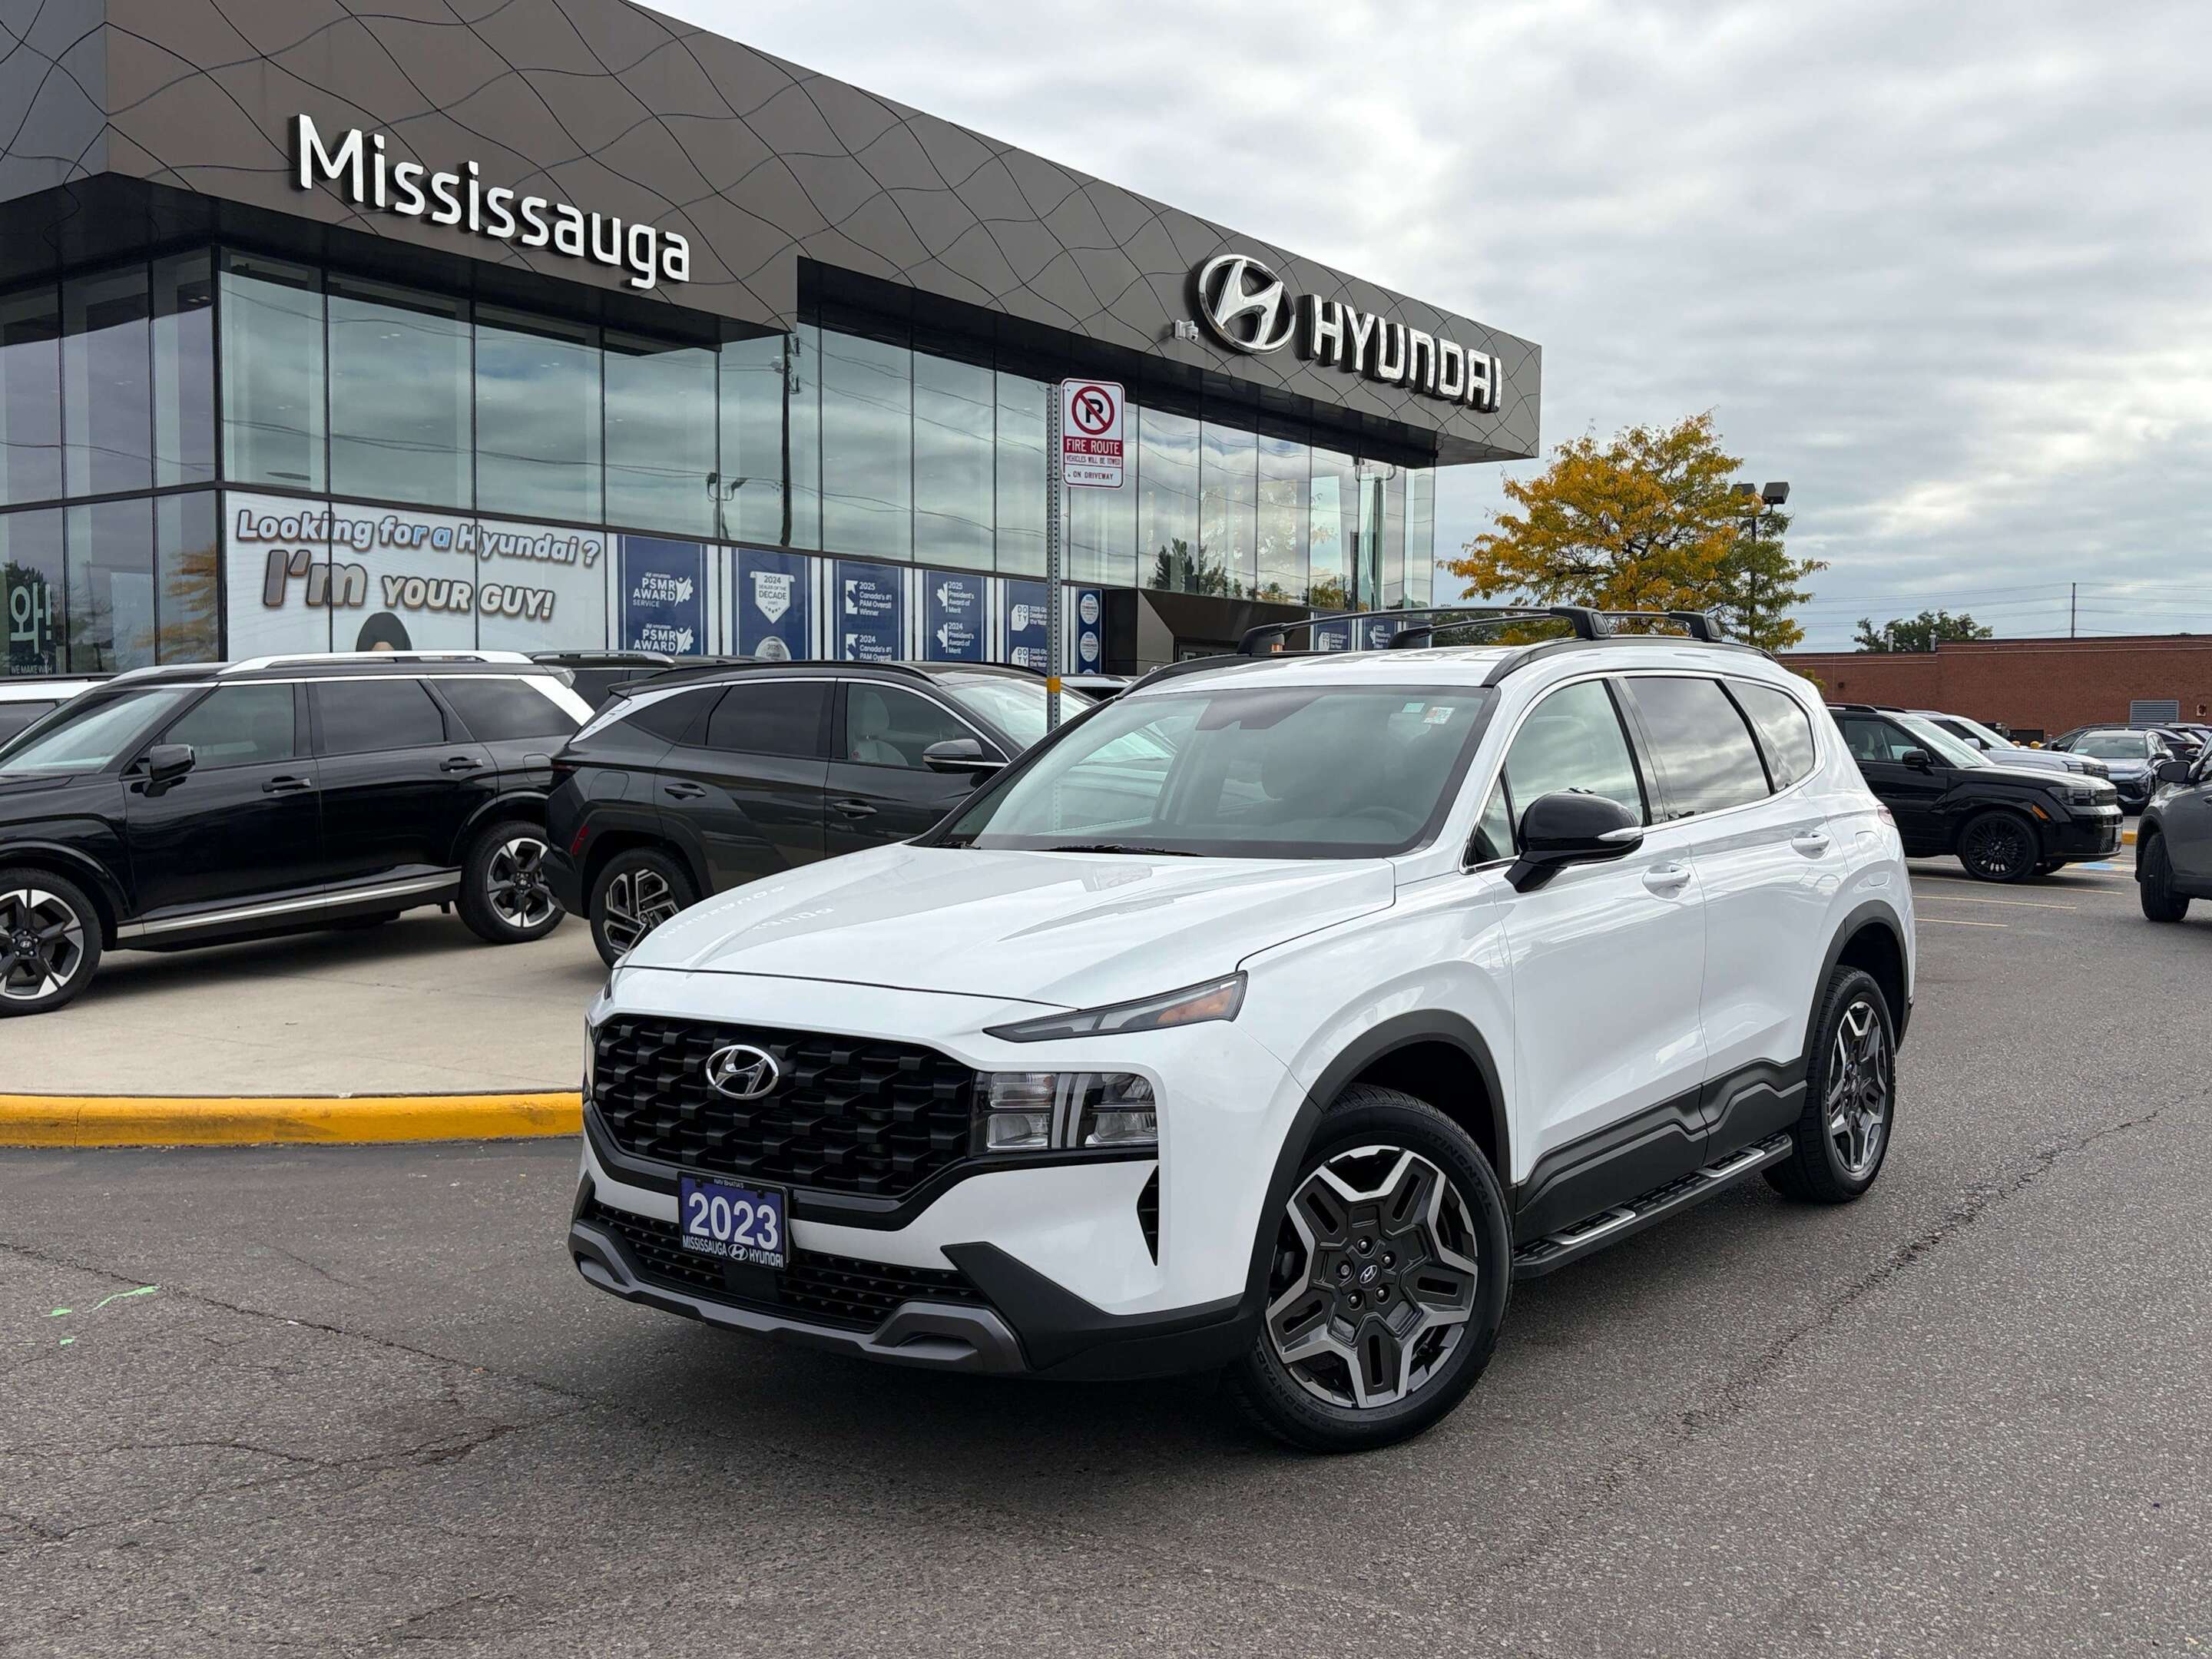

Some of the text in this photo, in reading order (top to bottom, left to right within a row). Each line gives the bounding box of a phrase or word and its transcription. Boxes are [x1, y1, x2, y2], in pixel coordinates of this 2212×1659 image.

[296, 113, 690, 290] Mississauga
[1307, 293, 1502, 412] HYUNDAI
[1066, 439, 1121, 455] FIRE ROUTE
[1066, 455, 1087, 463] VEHICLES
[1084, 472, 1114, 480] DRIVEWAY
[237, 509, 374, 551] Looking
[379, 515, 426, 548] for
[432, 525, 452, 548] a
[263, 549, 555, 620] I'm YOUR GUY!
[642, 577, 676, 591] PSMR
[763, 575, 781, 584] 2024
[859, 581, 876, 591] 2025
[633, 588, 676, 601] AWARD
[758, 590, 787, 600] DECADE
[859, 591, 886, 601] Canada's
[632, 599, 661, 608] SERVICE
[948, 621, 963, 631] 2024
[643, 628, 676, 642] PSMR
[859, 634, 876, 644] 2024
[634, 639, 676, 652] AWARD
[859, 644, 886, 653] Canada's
[859, 652, 873, 661] PAM
[688, 1192, 779, 1250] 2023
[682, 1235, 784, 1268] MISSISSAUGA HYUNDAI
